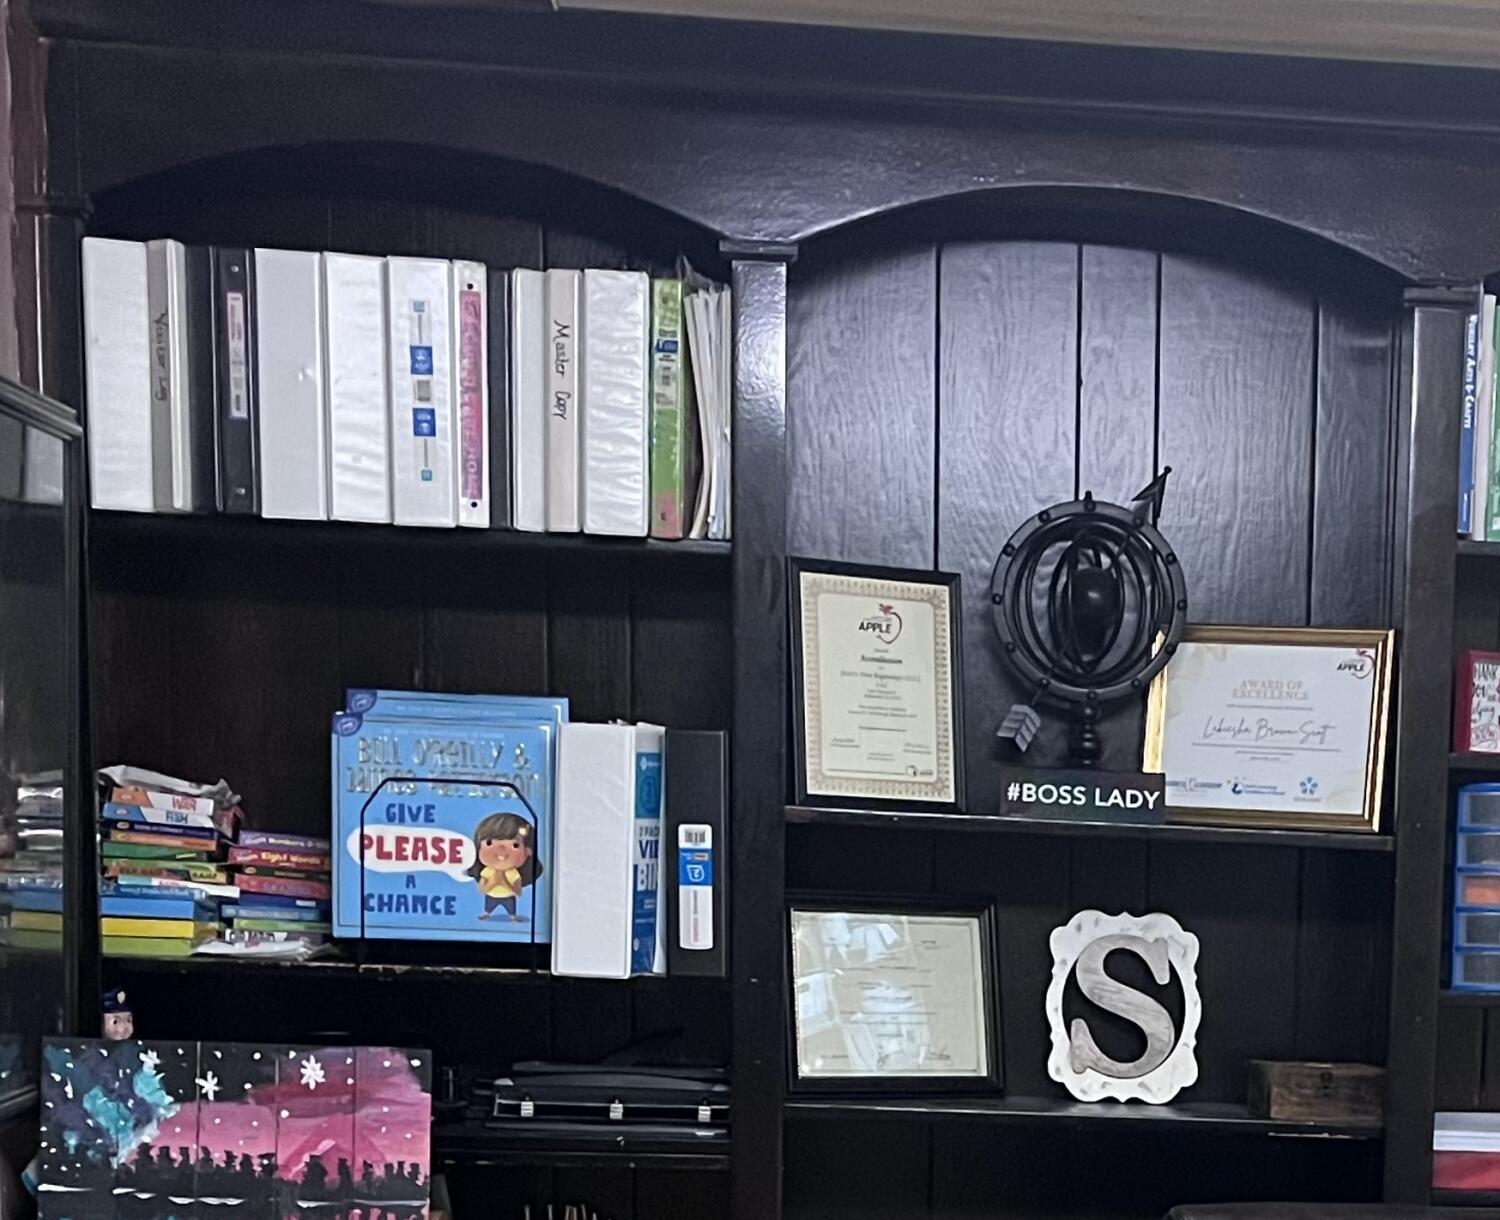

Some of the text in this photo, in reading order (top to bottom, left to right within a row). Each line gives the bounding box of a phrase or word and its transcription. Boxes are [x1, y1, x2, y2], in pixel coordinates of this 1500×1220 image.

[553, 319, 571, 377] Master
[859, 620, 892, 634] APPLE
[1337, 663, 1366, 673] APPLE
[1232, 688, 1308, 701] EXCELLENCE
[1240, 679, 1304, 691] AWARD OF
[1007, 782, 1160, 810] #BOSS LADY
[385, 803, 436, 823] GIVE
[362, 835, 464, 864] PLEASE
[405, 874, 417, 889] A
[363, 892, 457, 916] CHANCE
[1071, 932, 1175, 1079] S
